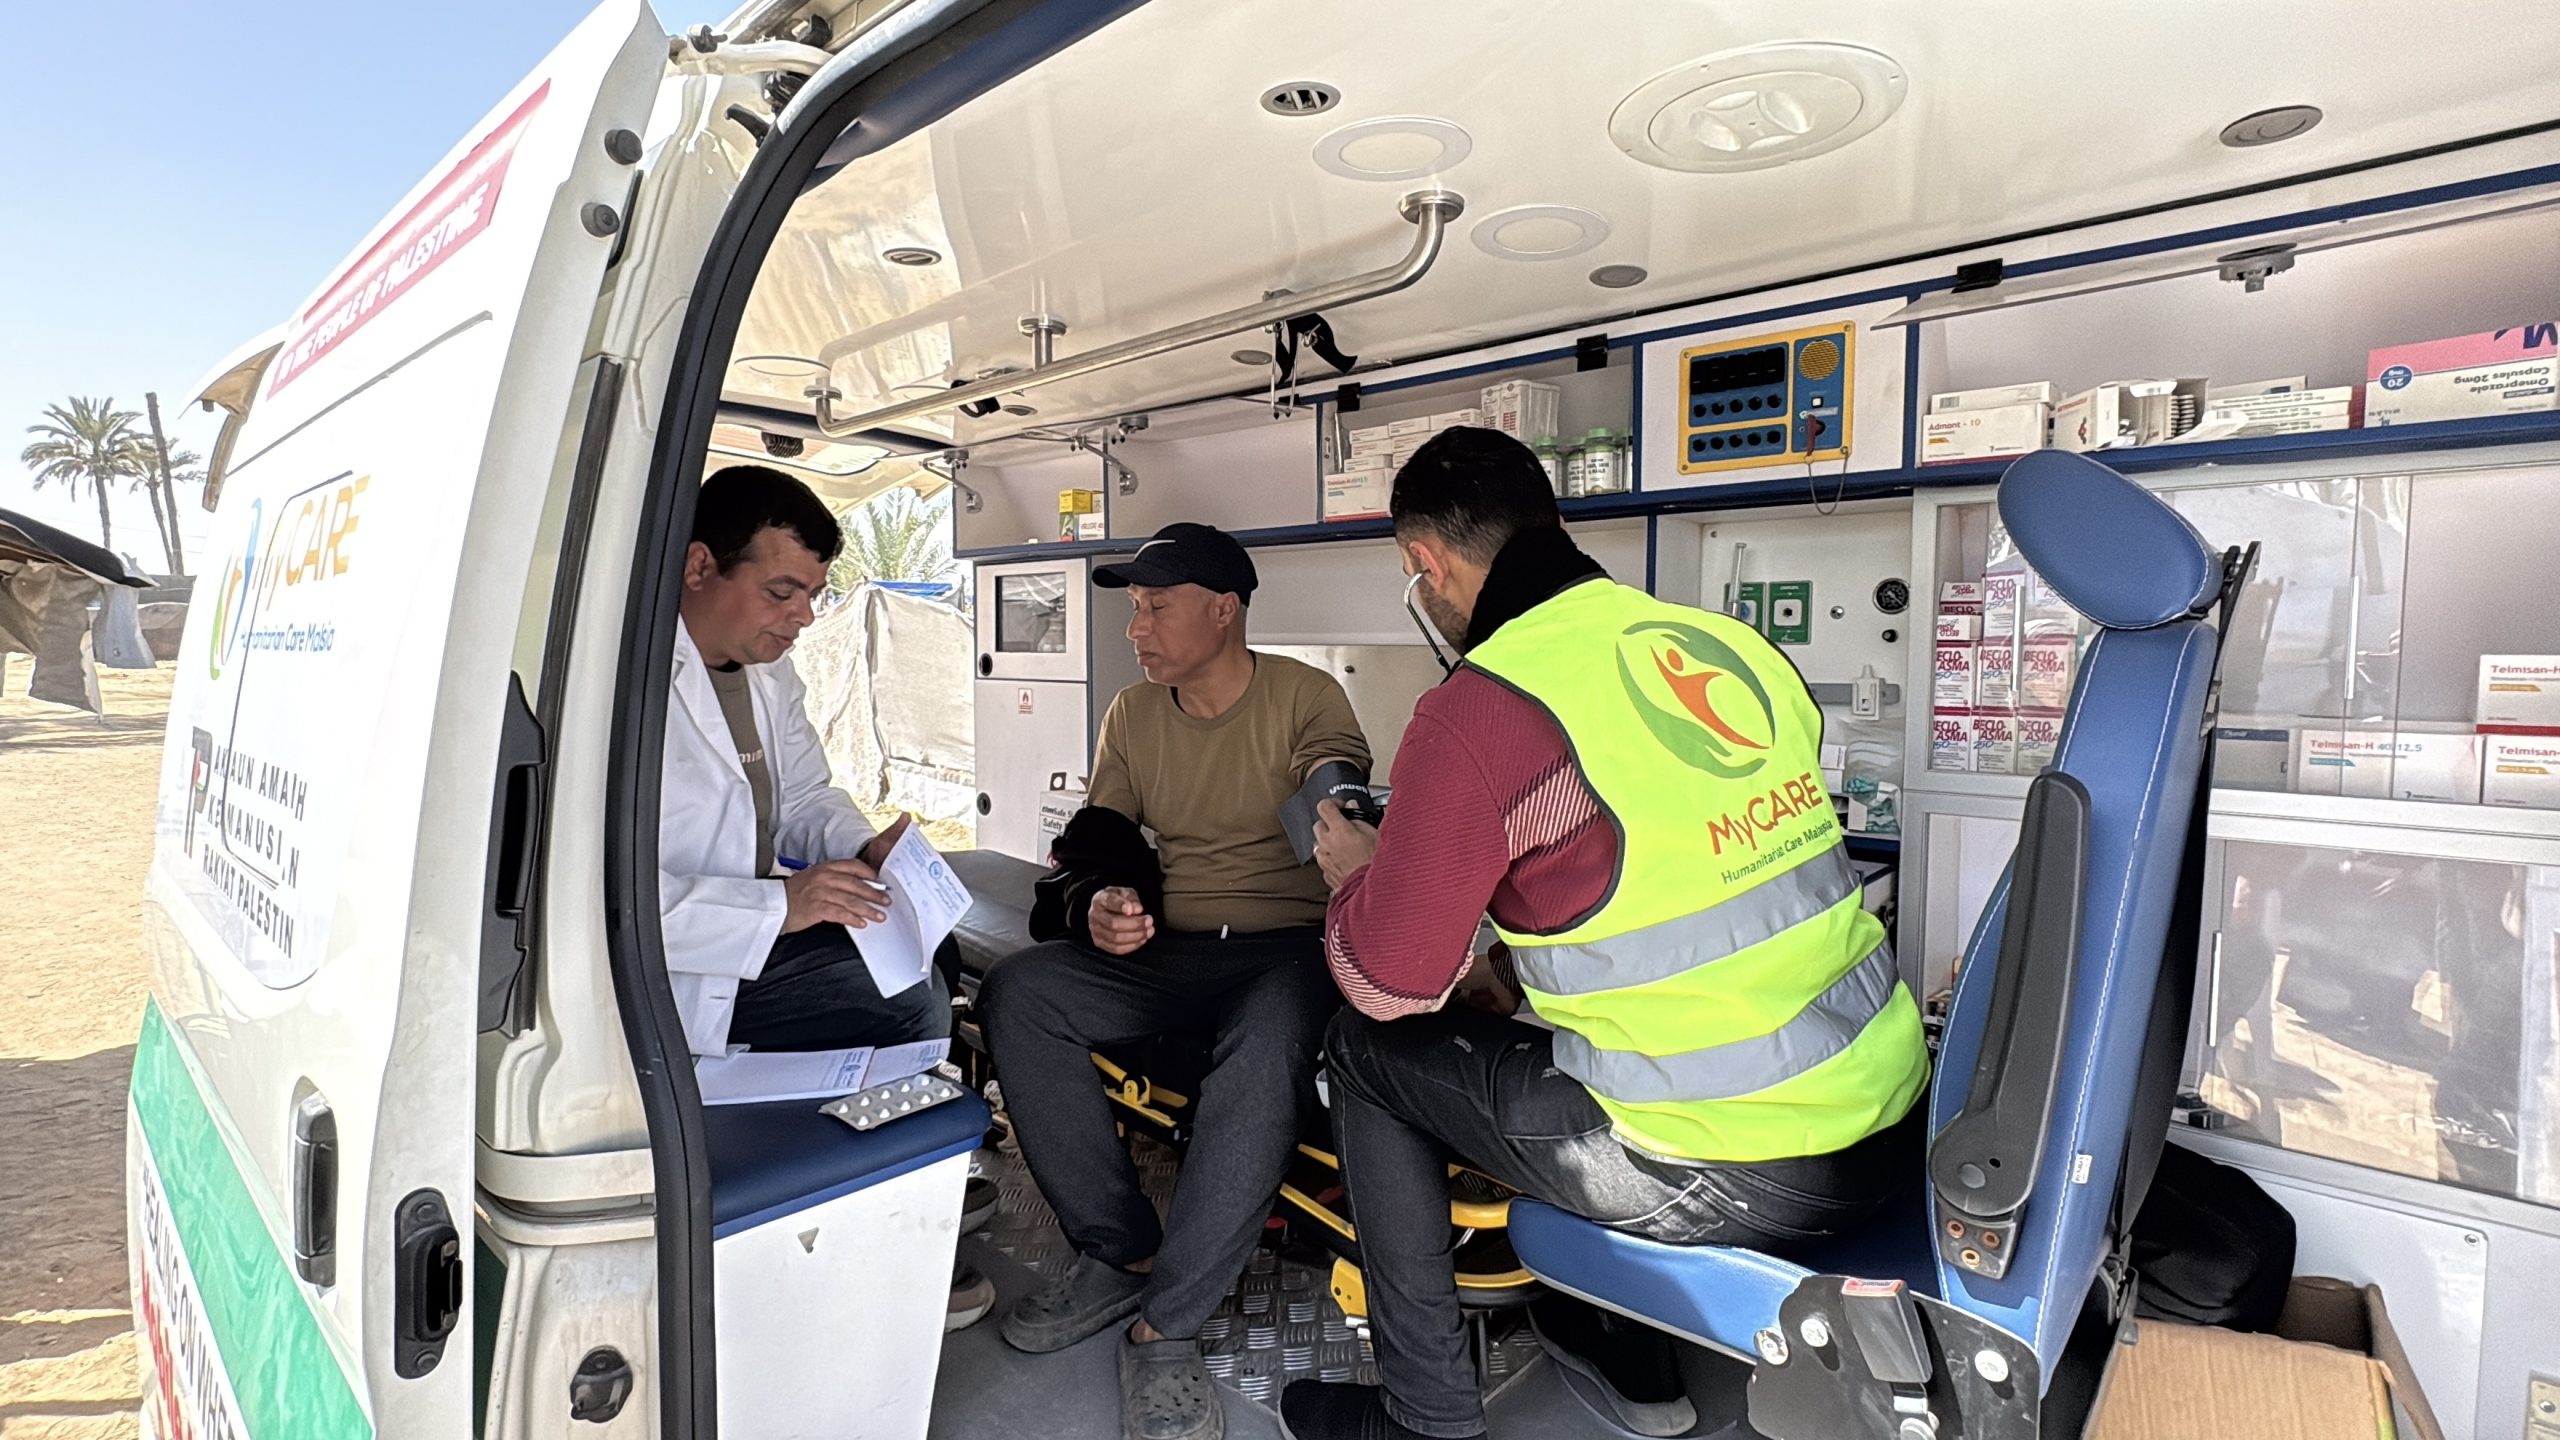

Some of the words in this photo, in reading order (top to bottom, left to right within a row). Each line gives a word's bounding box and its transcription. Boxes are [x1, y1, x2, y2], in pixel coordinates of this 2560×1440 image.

[380, 181, 489, 300] PALESTINE
[2491, 366, 2551, 381] Capsules
[2386, 377, 2405, 388] 20
[2468, 377, 2550, 395] Omeprazole
[1992, 589, 2016, 601] ASM
[1936, 650, 1963, 662] ECLO-
[1937, 660, 1970, 672] ASMA
[1986, 659, 2013, 671] ASM
[2030, 660, 2066, 673] ASMA
[1935, 730, 1968, 742] ASMA
[1978, 730, 2013, 742] ASMA
[2377, 743, 2423, 753] 4012.5
[1706, 771, 1824, 856] MyCARE
[1784, 836, 1804, 852] Care
[202, 842, 236, 900] RAKYAT
[236, 872, 295, 960] PALESTIN
[179, 1283, 197, 1388] ON
[197, 1329, 236, 1440] WHE
